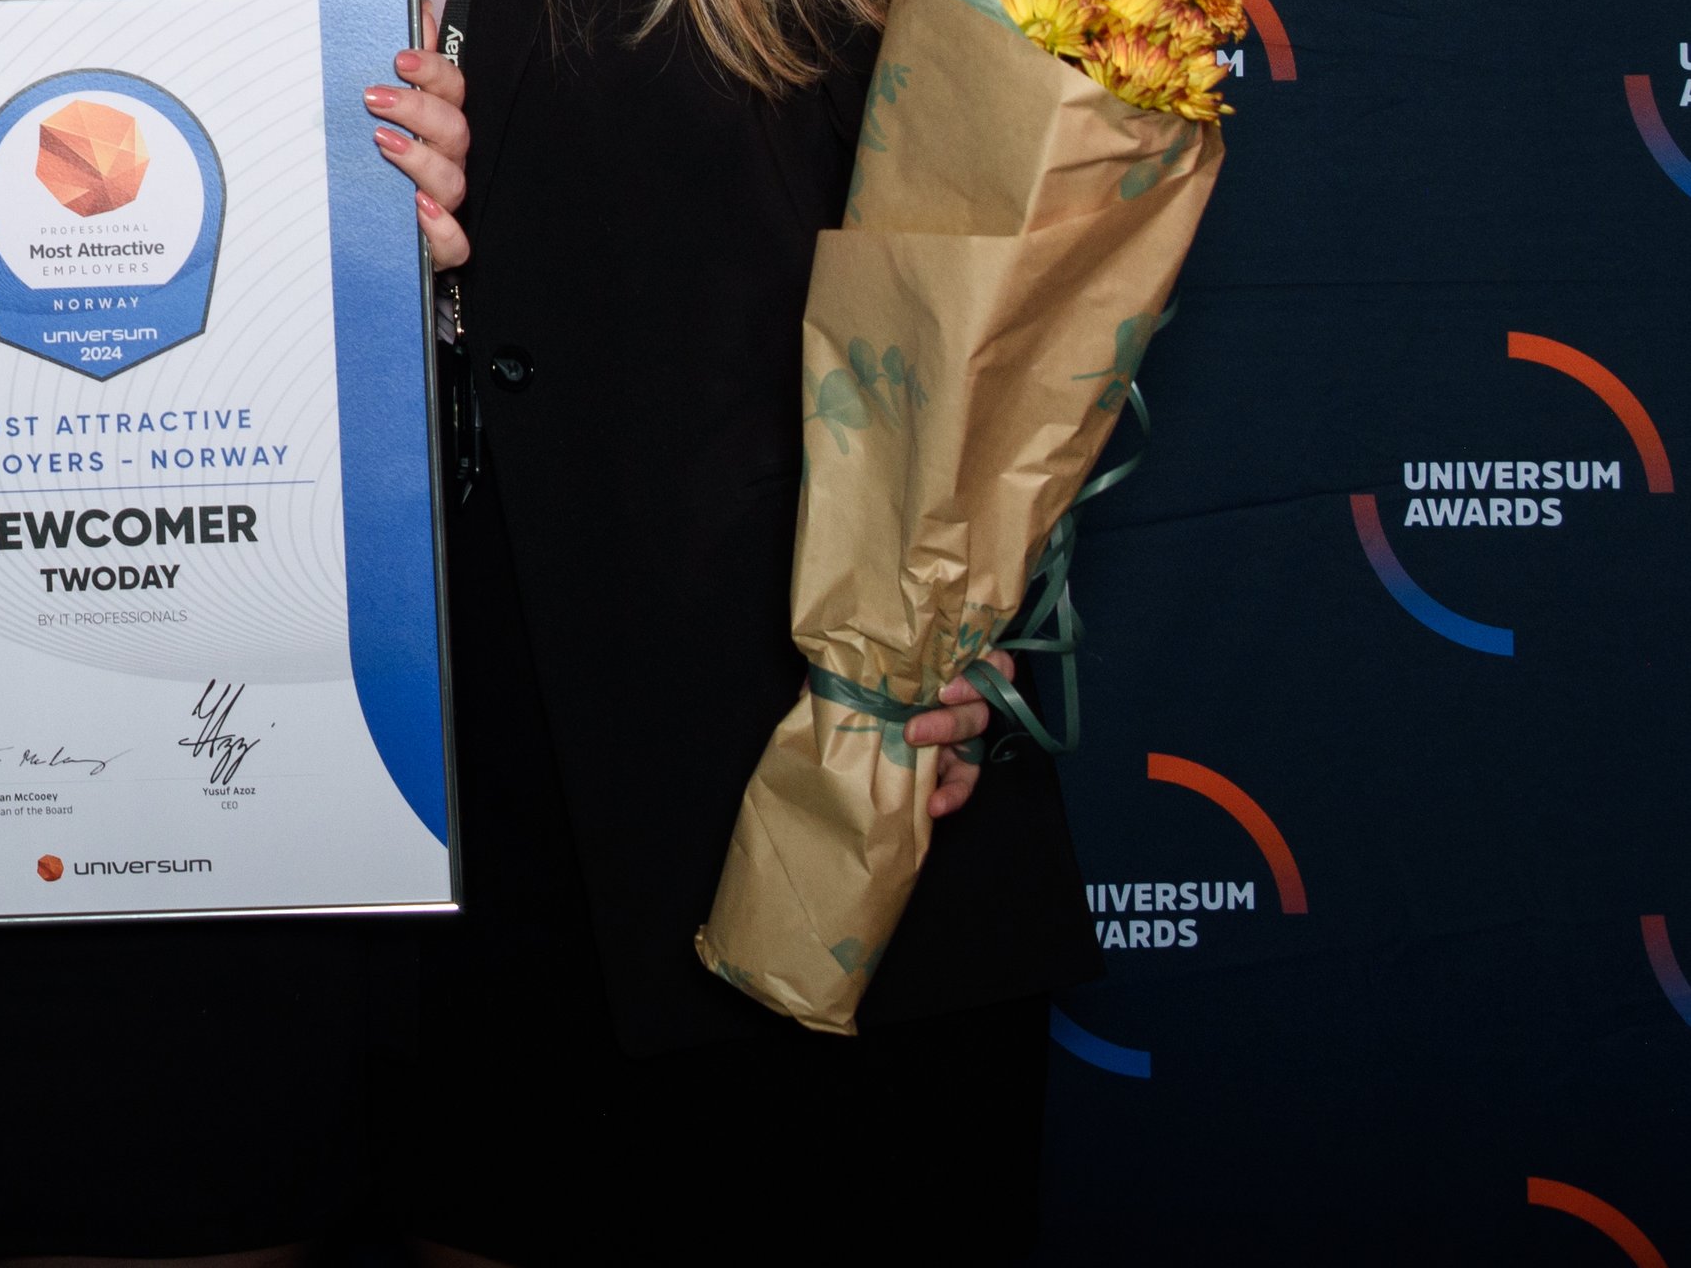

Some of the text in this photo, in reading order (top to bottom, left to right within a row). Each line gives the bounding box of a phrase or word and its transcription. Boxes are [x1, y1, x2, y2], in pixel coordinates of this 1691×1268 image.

[40, 223, 149, 235] PROFESSIONAL
[29, 241, 165, 259] Most Attractive
[42, 262, 150, 277] EMPLOYERS
[53, 296, 140, 311] NORWAY
[43, 328, 158, 343] universum
[80, 346, 123, 361] 2024
[55, 408, 252, 435] ATTRACTIVE
[151, 444, 289, 470] NORWAY
[1404, 461, 1621, 491] UNIVERSUM
[1404, 497, 1563, 527] AWARDS
[39, 564, 181, 593] TWODAY
[37, 608, 188, 627] BY IT PROFESSIONALS
[14, 791, 58, 803] McCooey
[202, 786, 256, 796] Yusuf Azoz
[14, 806, 24, 816] of
[26, 806, 43, 815] the
[45, 805, 73, 815] Board
[221, 800, 239, 810] CEO
[74, 858, 212, 876] universum
[1086, 881, 1255, 912] IVERSUM
[1096, 918, 1199, 949] ARDS
